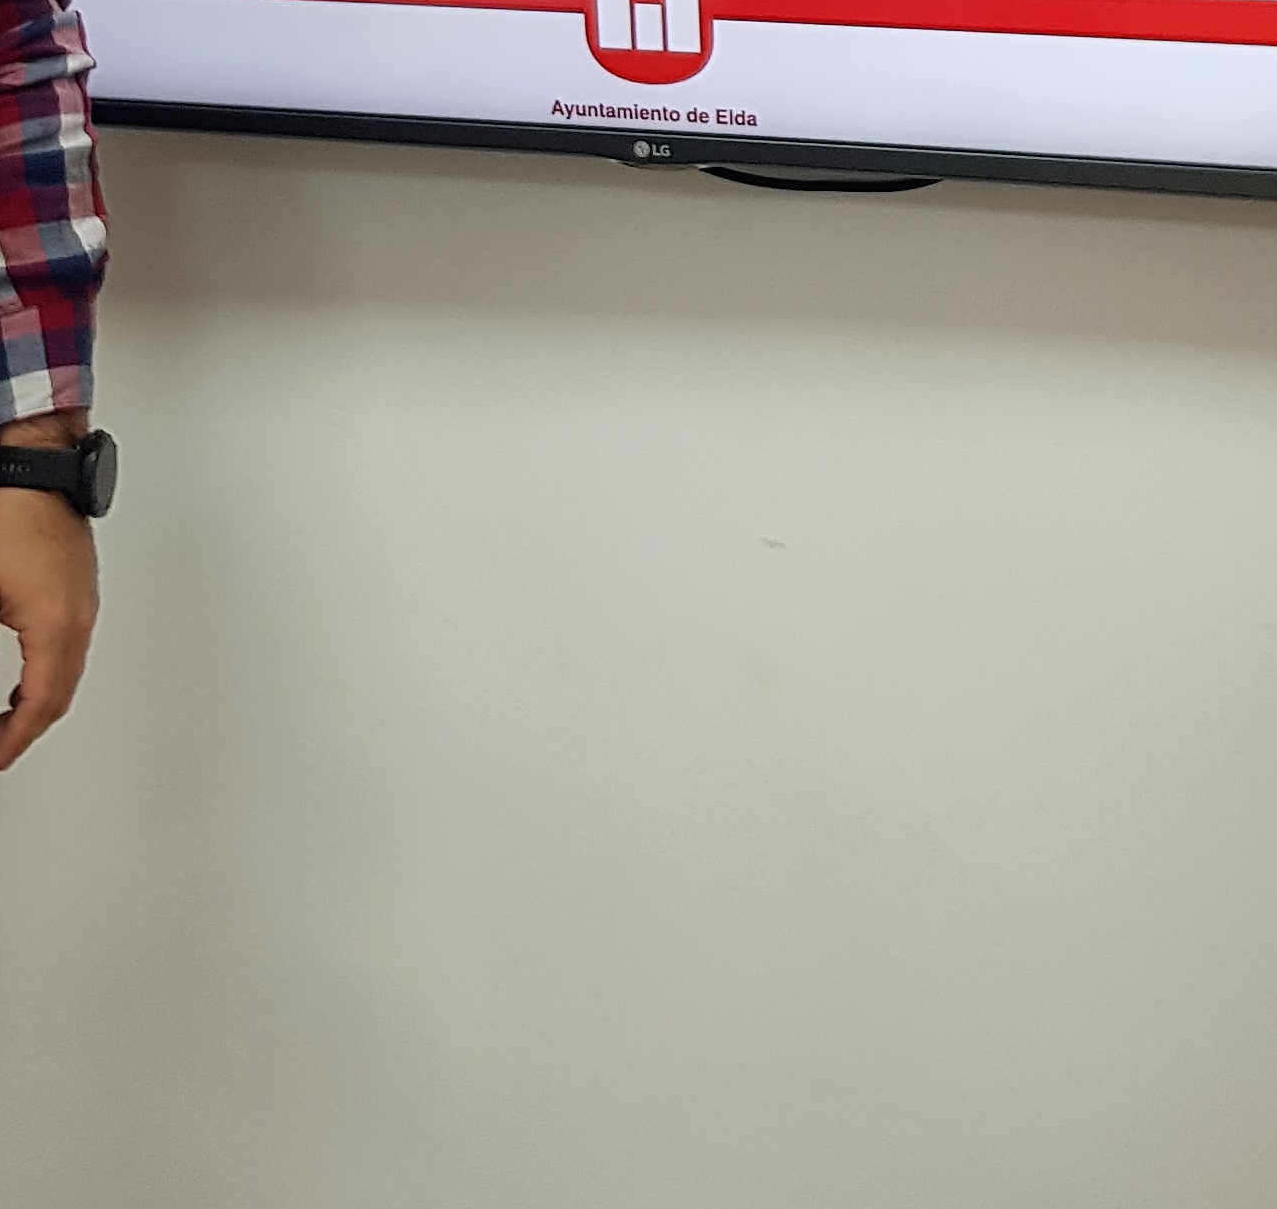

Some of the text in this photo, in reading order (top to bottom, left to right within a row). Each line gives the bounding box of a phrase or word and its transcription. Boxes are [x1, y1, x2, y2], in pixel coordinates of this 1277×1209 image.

[551, 99, 758, 127] Ayuntamiento de Elda
[651, 143, 672, 157] LG
